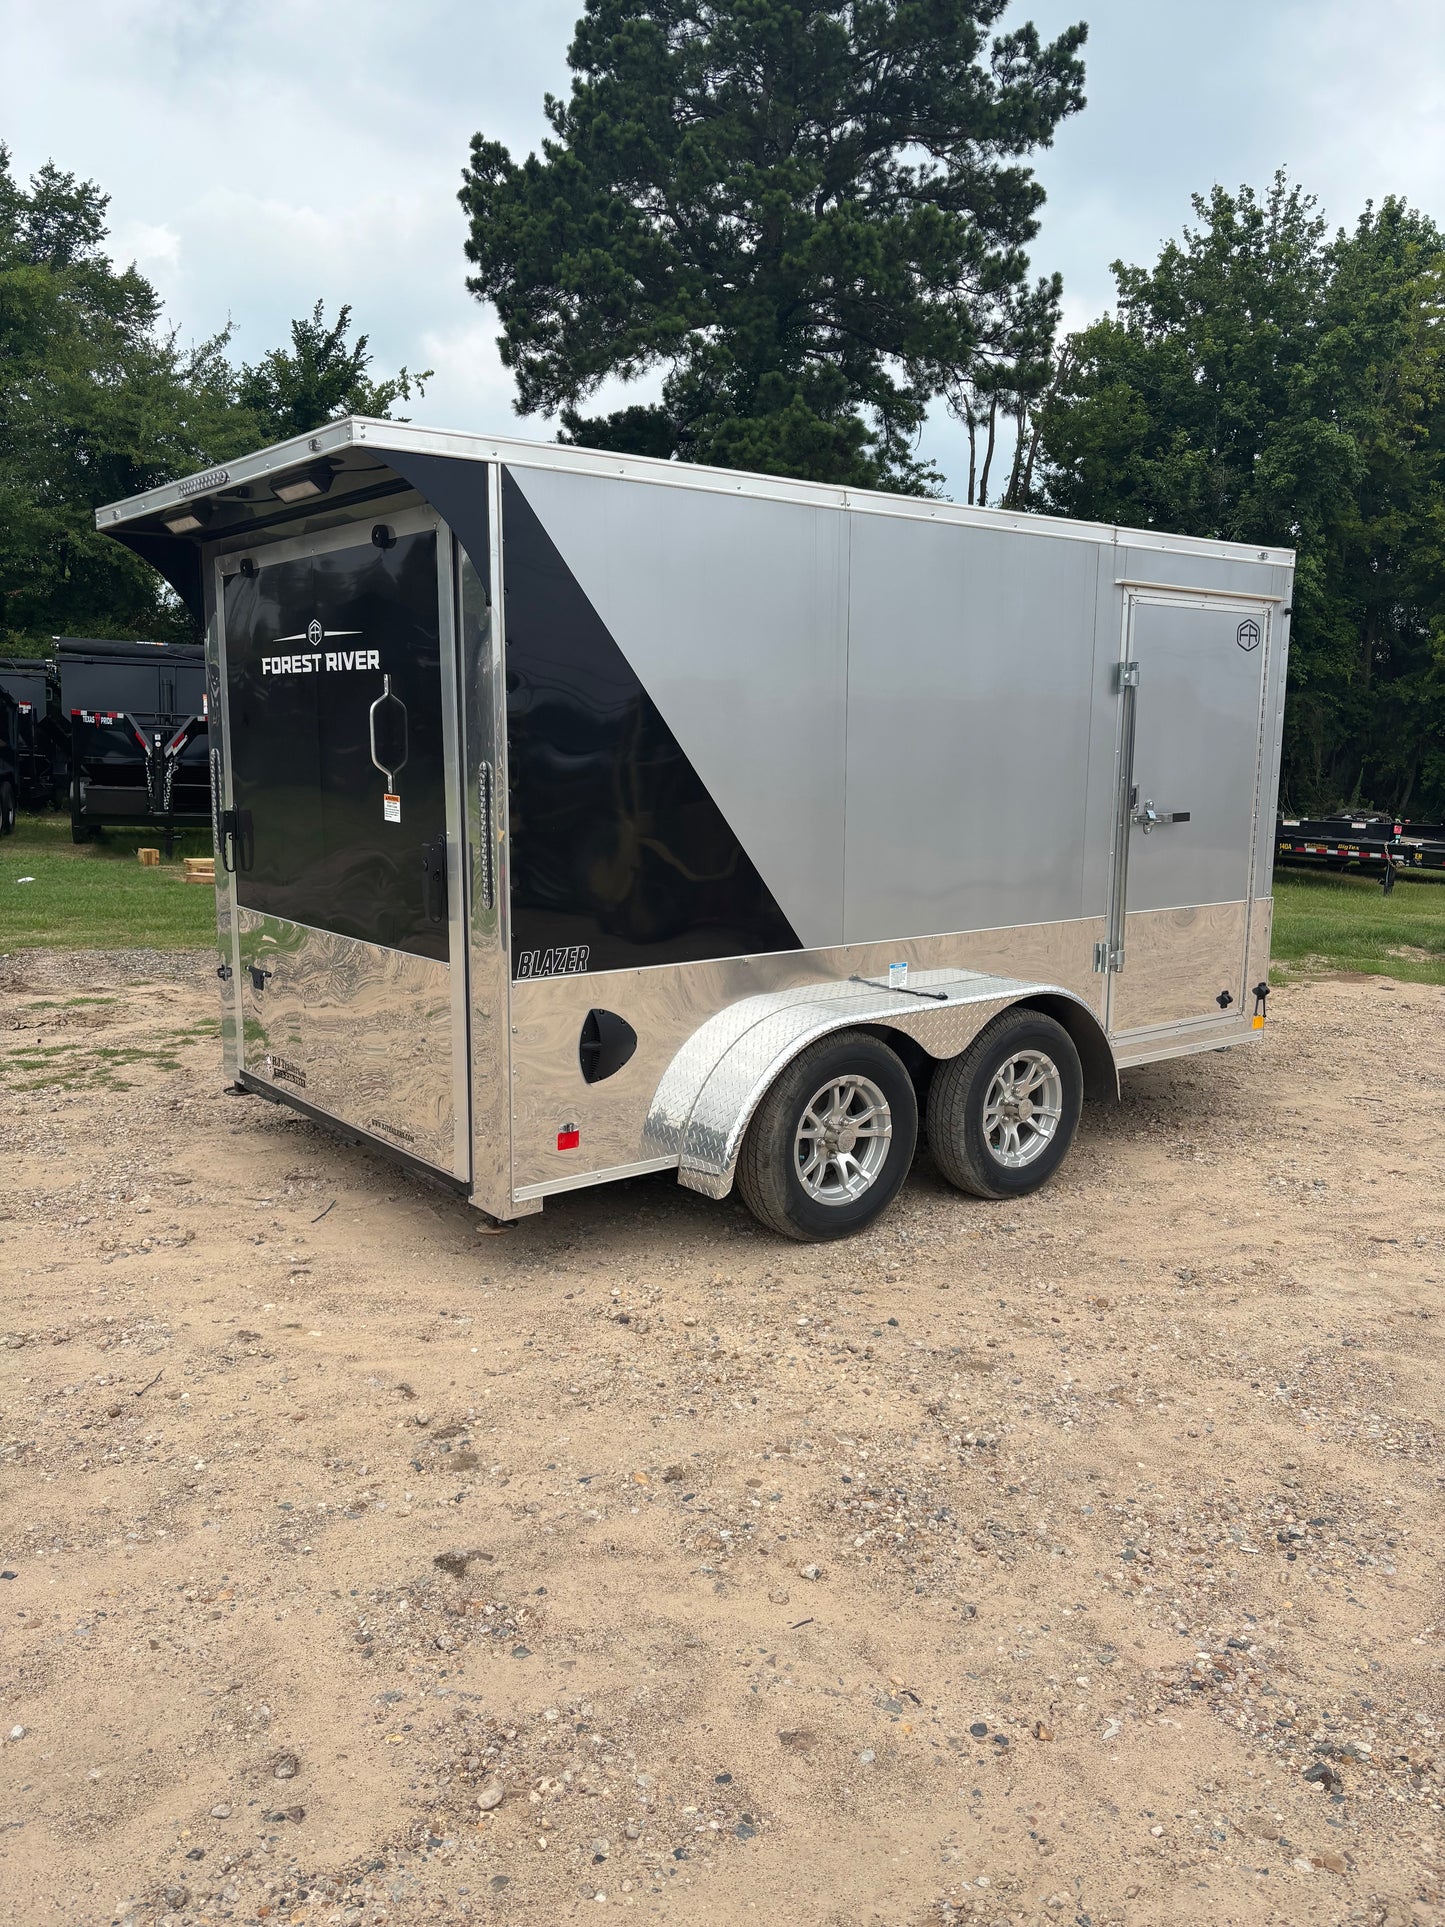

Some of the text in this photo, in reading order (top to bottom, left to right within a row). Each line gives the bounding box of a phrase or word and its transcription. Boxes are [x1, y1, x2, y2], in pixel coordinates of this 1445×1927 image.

[261, 649, 380, 675] FOREST RIVER
[82, 715, 113, 725] TEXAS PRIDE
[517, 945, 590, 979] BLAZER
